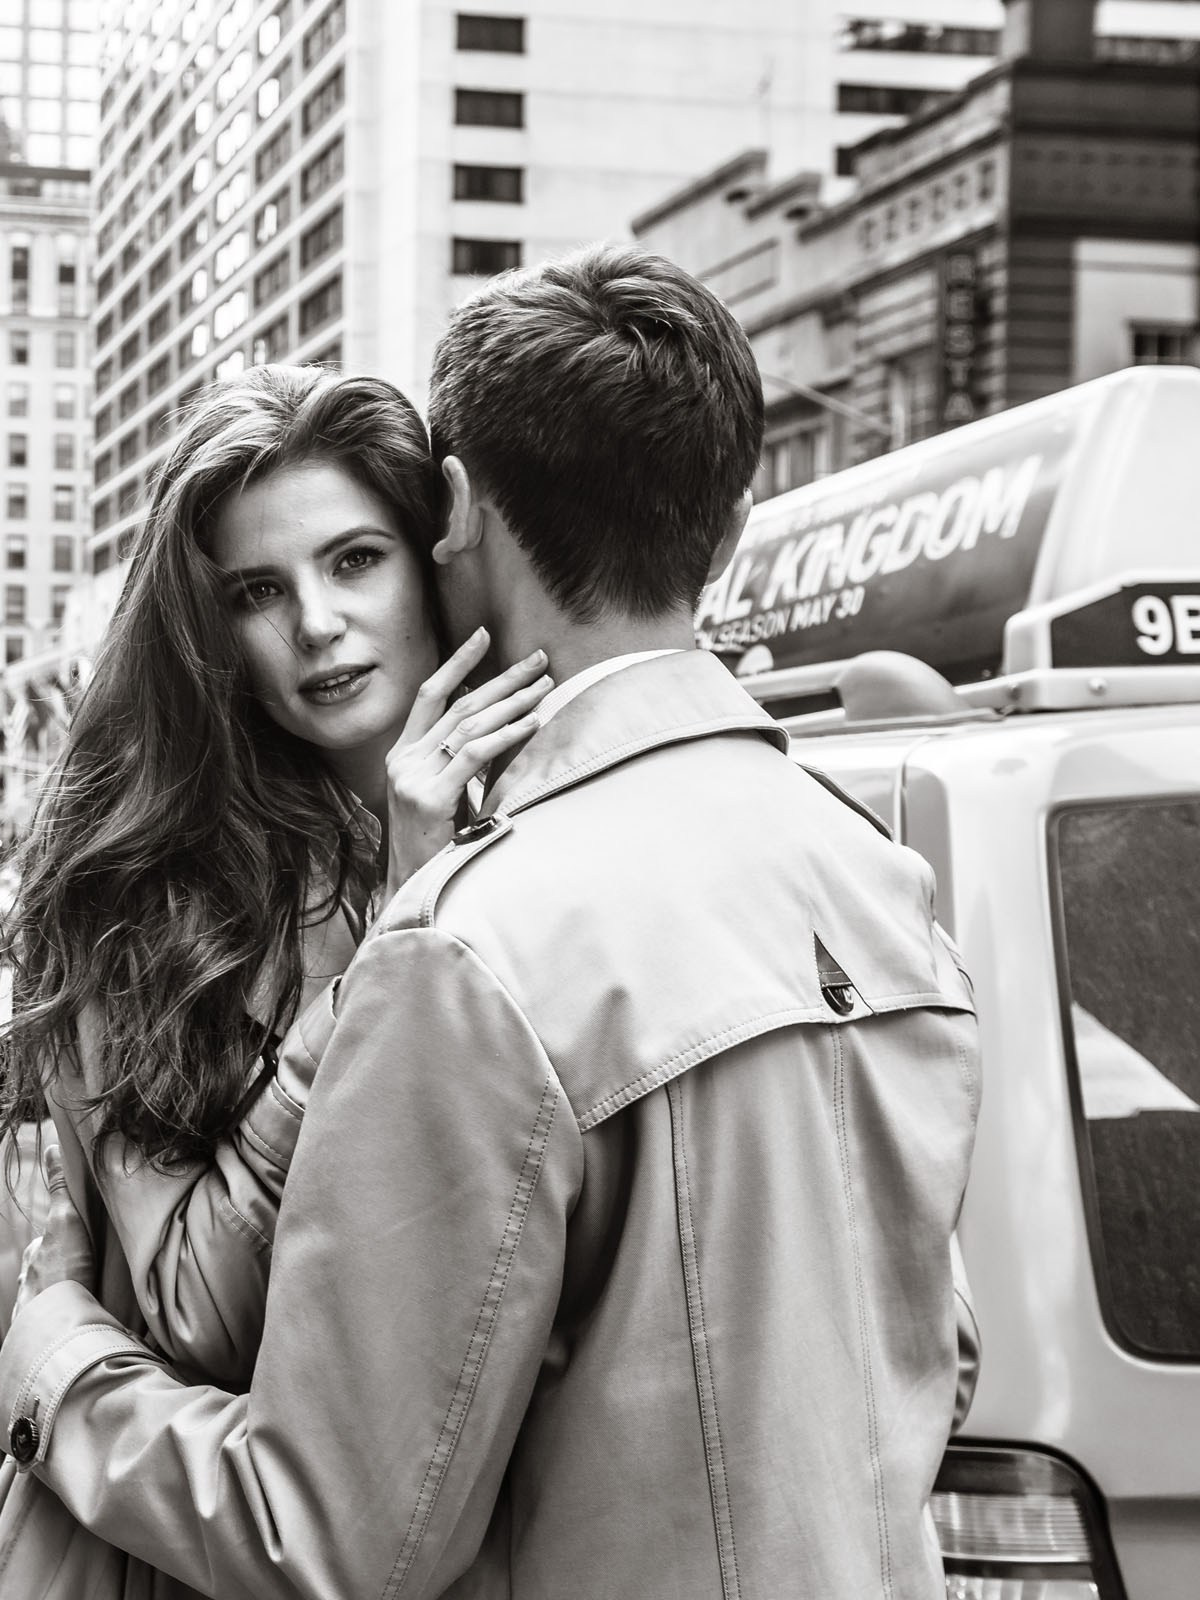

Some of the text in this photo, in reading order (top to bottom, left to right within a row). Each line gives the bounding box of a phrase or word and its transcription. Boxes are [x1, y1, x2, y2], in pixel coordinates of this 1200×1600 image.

[762, 453, 1043, 610] KINGDOM
[719, 607, 790, 643] SEASON
[789, 593, 837, 632] MAY
[835, 585, 866, 619] 30
